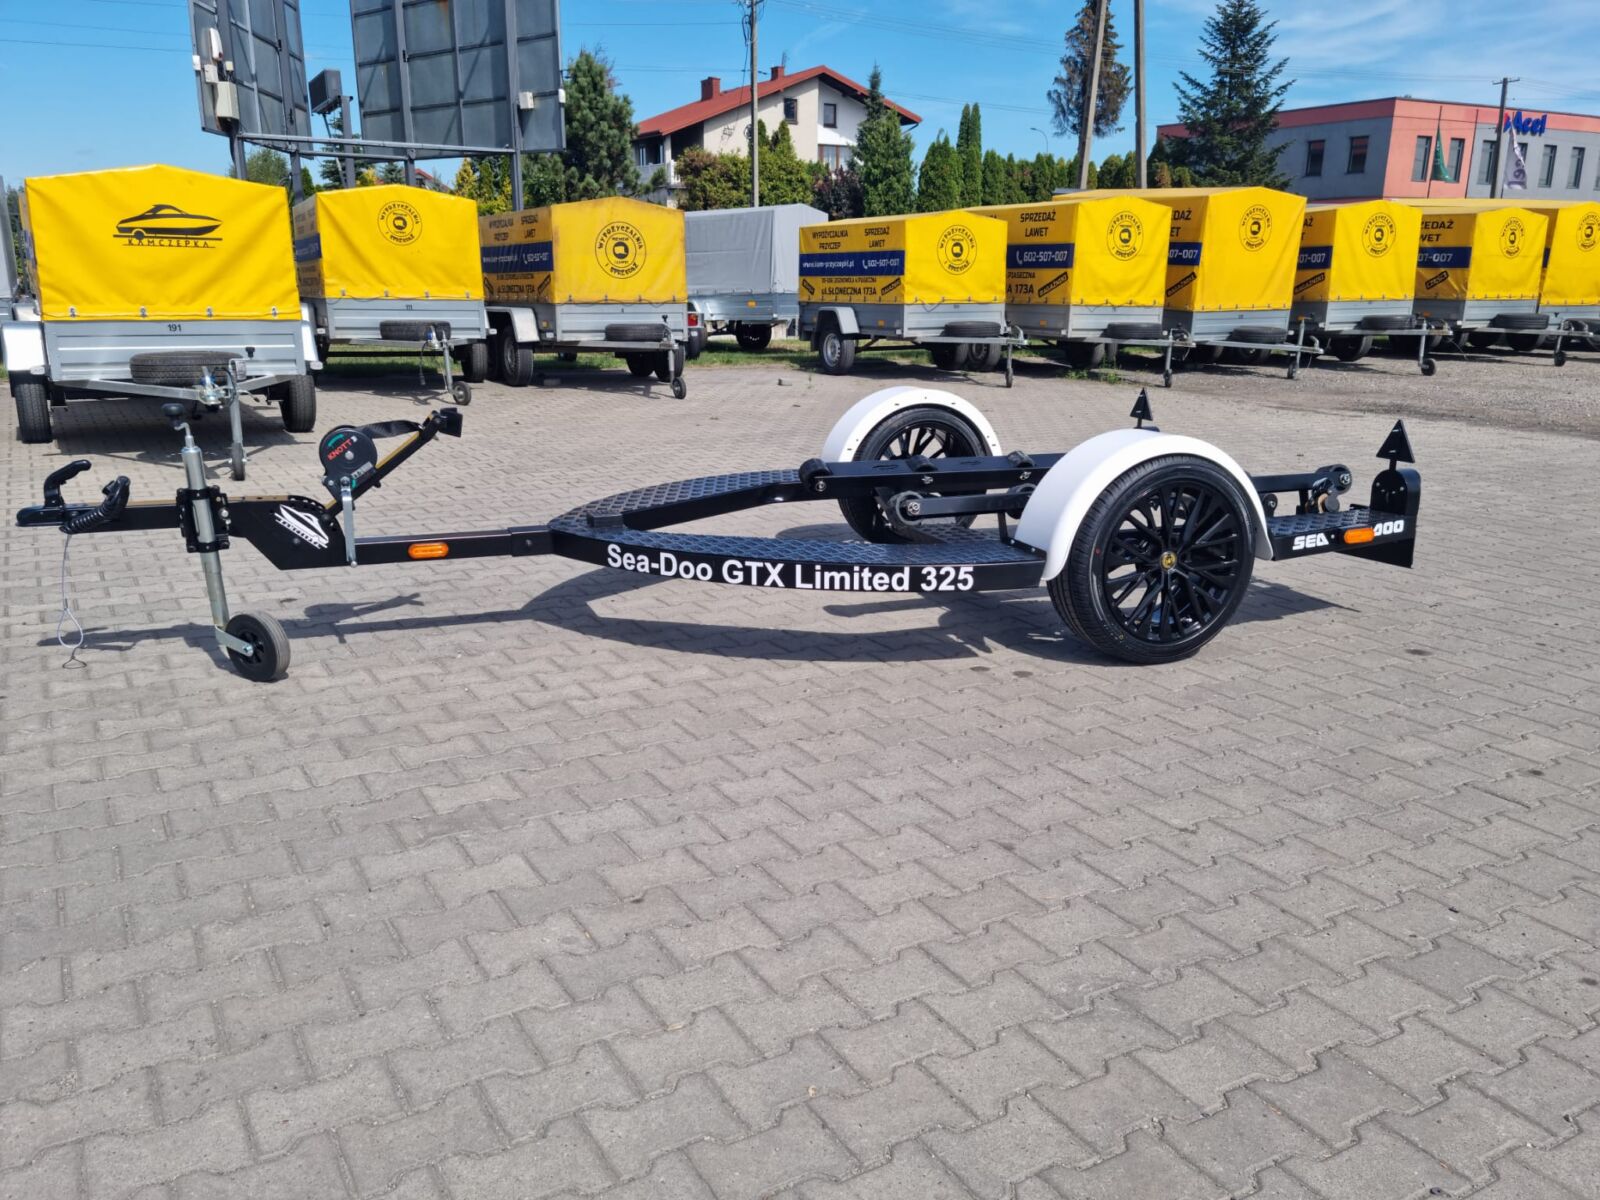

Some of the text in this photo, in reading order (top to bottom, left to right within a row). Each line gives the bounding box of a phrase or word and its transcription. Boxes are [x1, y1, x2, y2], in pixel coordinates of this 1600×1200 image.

[1020, 208, 1056, 222] SPRZEDAŻ
[1172, 208, 1192, 221] DAŻ
[1024, 227, 1049, 237] LAWET
[127, 239, 210, 248] KAMCZEPKA
[868, 239, 886, 248] LAWET
[1023, 250, 1068, 262] 602-507-007
[863, 286, 877, 296] 173A
[1015, 284, 1034, 294] 173A
[167, 323, 182, 332] 191
[327, 438, 353, 460] KNOTT
[1292, 532, 1330, 551] SEA
[607, 543, 974, 592] Sea-Doo GTX Limited 325
